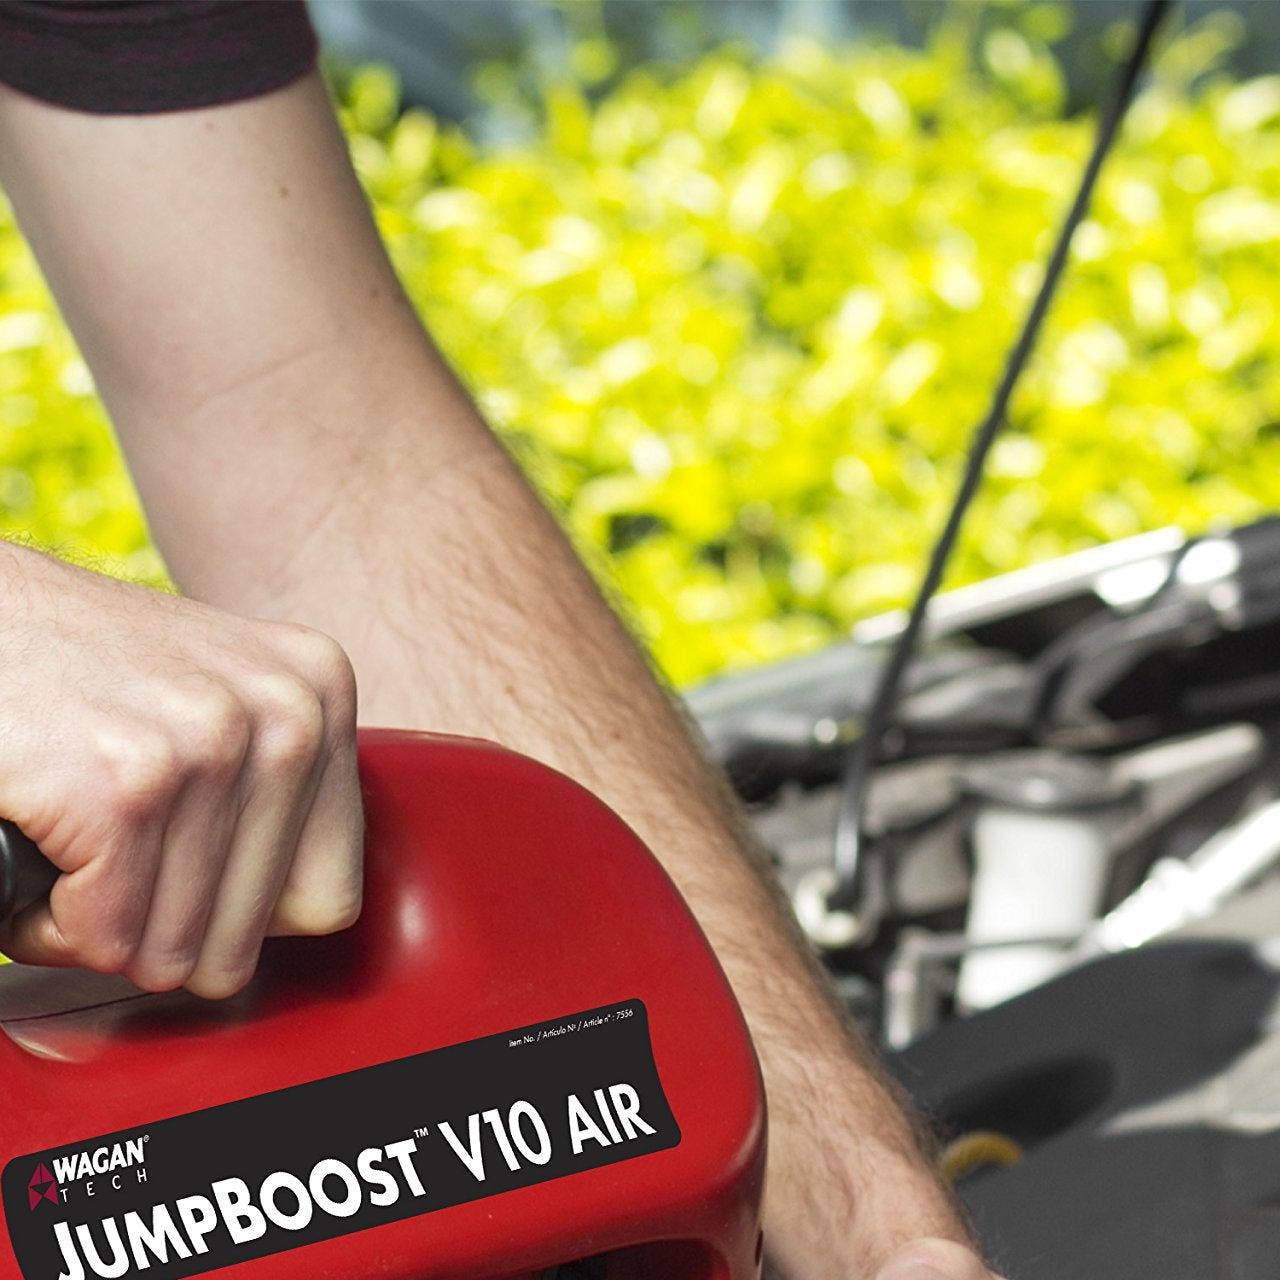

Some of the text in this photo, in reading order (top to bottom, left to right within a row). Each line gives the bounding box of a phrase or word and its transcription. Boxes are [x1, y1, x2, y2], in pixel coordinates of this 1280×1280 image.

[583, 1016, 603, 1028] Article
[616, 1008, 634, 1020] 7556
[437, 1100, 552, 1182] V10
[568, 1083, 656, 1154] AIR
[60, 1168, 148, 1203] TECH
